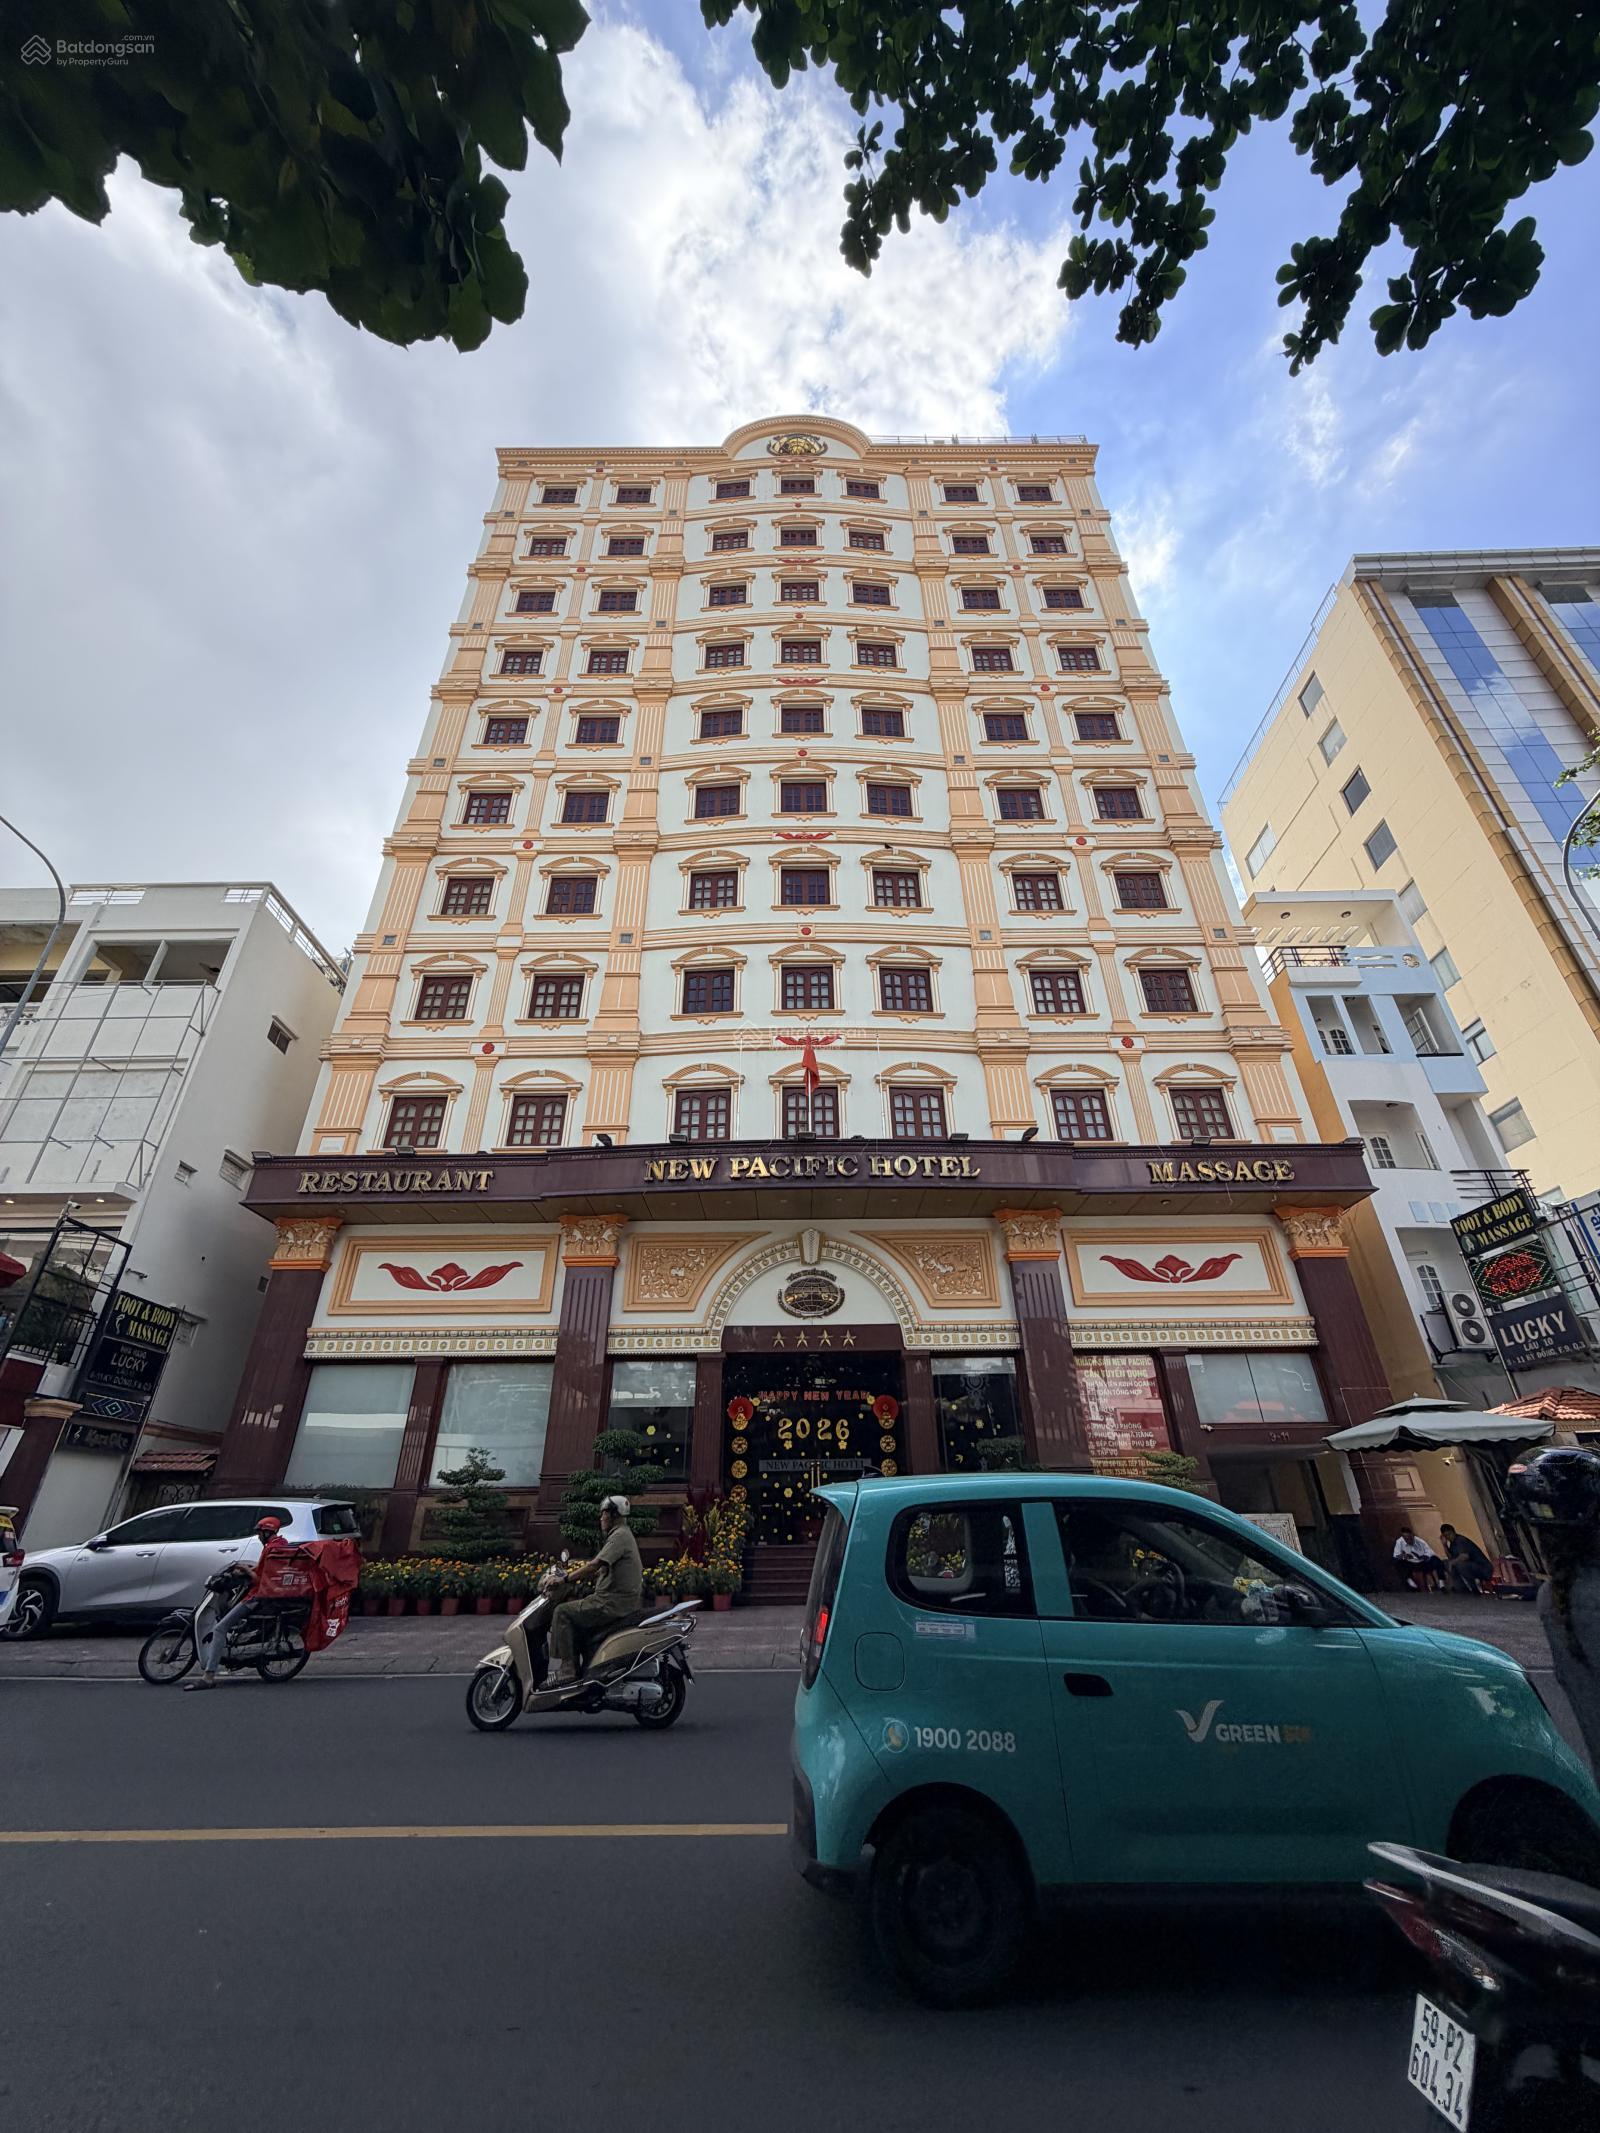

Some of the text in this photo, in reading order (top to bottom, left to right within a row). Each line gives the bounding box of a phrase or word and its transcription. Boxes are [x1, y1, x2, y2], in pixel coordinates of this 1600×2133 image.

[296, 1168, 494, 1193] RESTAURANT
[644, 1154, 981, 1182] NEW PACIFIC HOTEL
[1148, 1160, 1295, 1182] MASSAGE
[1453, 1193, 1526, 1237] FOOT & BODY
[1476, 1212, 1535, 1248] MASSAGE
[115, 1295, 178, 1328] FOOT & BODY
[126, 1320, 171, 1347] MASSAGE
[1500, 1310, 1567, 1348] LUCKY
[1543, 1337, 1555, 1347] 10
[110, 1352, 149, 1372] LUCKY
[1112, 1357, 1127, 1366] NEW
[1128, 1357, 1153, 1366] PACIFIC
[760, 1390, 869, 1401] HAPPY NEW YEAR
[778, 1418, 850, 1440] 2026
[766, 1460, 789, 1470] NEW
[914, 1727, 1017, 1753] 1900 2088
[1215, 1723, 1282, 1744] GREEN
[1421, 2003, 1465, 2074] 59-P2
